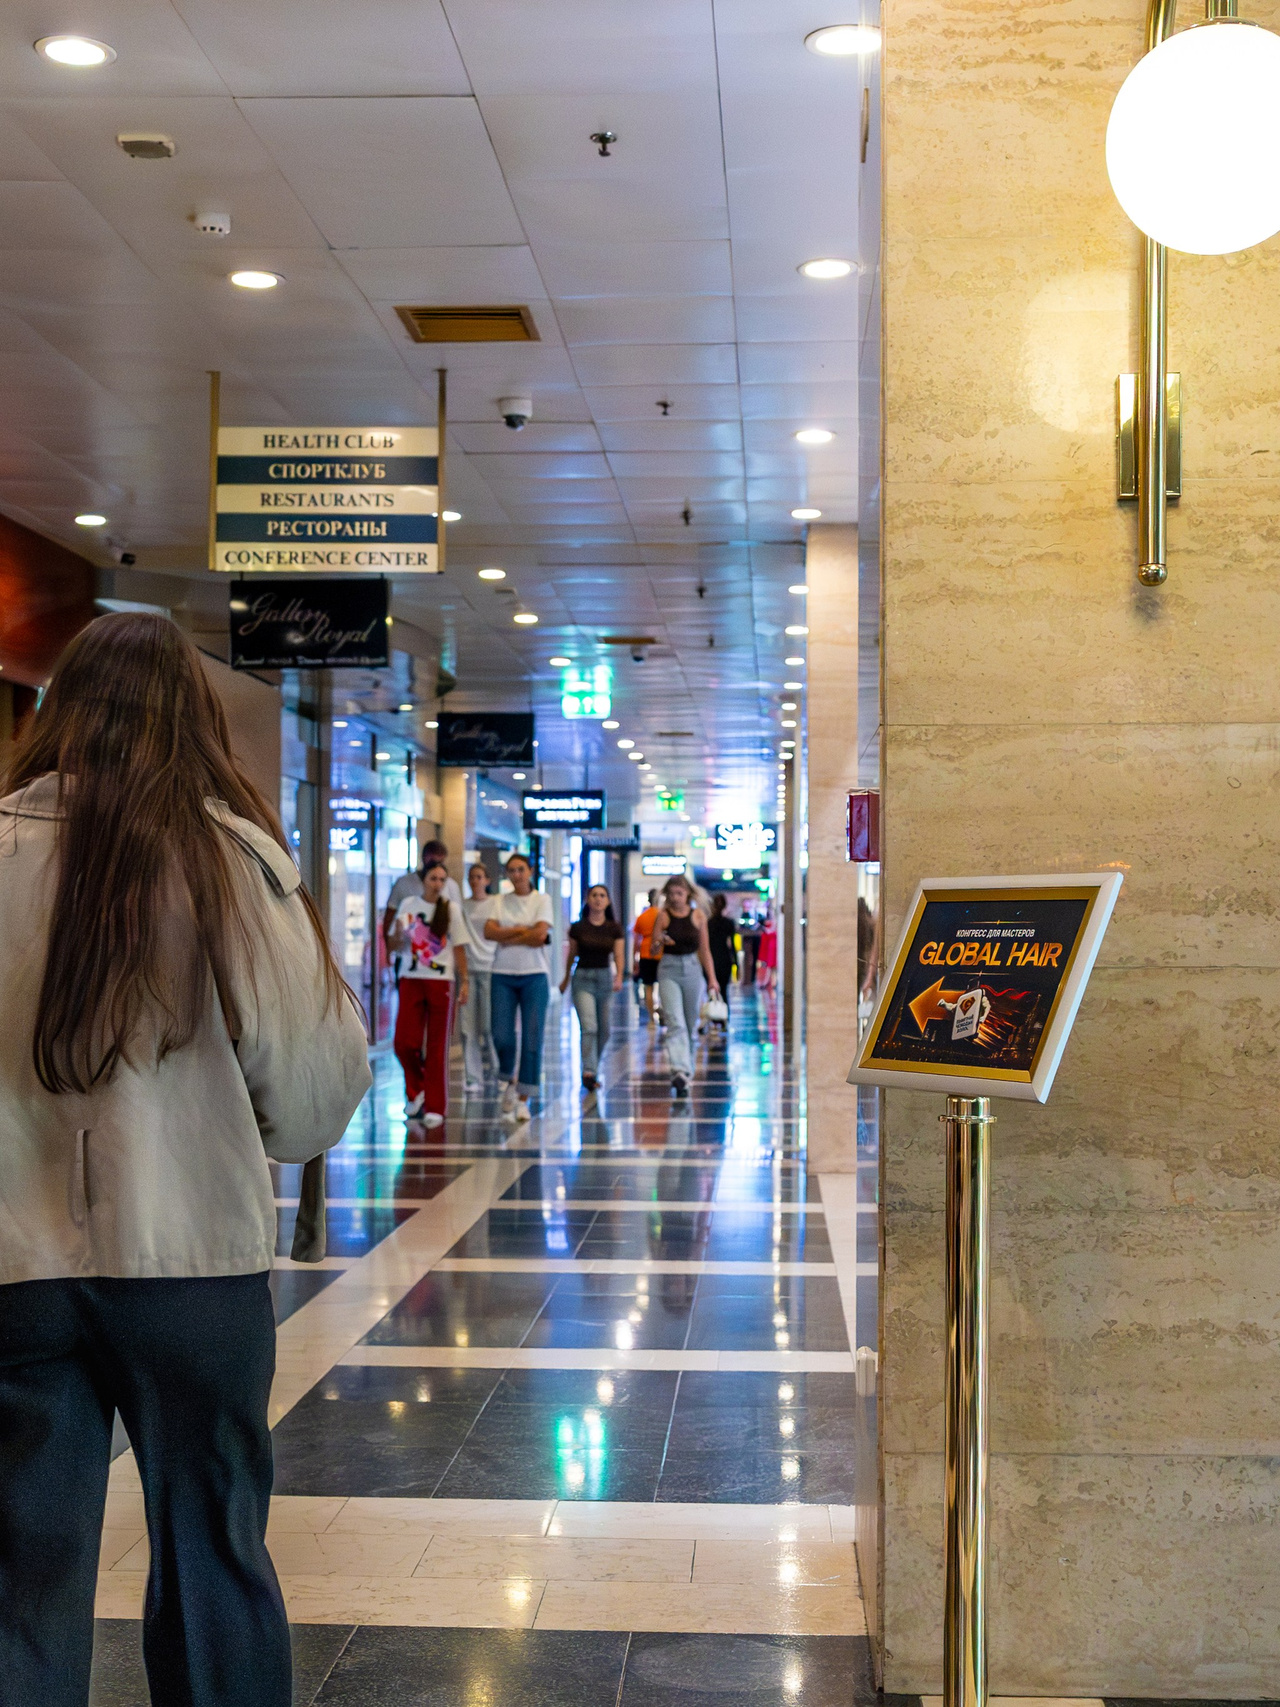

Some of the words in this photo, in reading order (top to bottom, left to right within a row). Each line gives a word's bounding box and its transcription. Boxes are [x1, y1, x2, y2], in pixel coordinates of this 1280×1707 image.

[263, 434, 339, 449] HEALTH
[344, 434, 394, 449] CLUB
[268, 463, 387, 479] СПОРТКЛУБ
[260, 492, 395, 508] RESTAURANTS
[267, 520, 388, 537] РЕСТОРАНЫ
[224, 550, 351, 566] CONFERENCE
[355, 550, 429, 566] CENTER
[956, 929, 987, 938] КОНГРЕСС
[986, 929, 1001, 938] ДЛЯ
[1001, 929, 1035, 937] МАСТЕРОВ
[919, 941, 1001, 966] GLOBAL
[1006, 942, 1063, 968] HAIR
